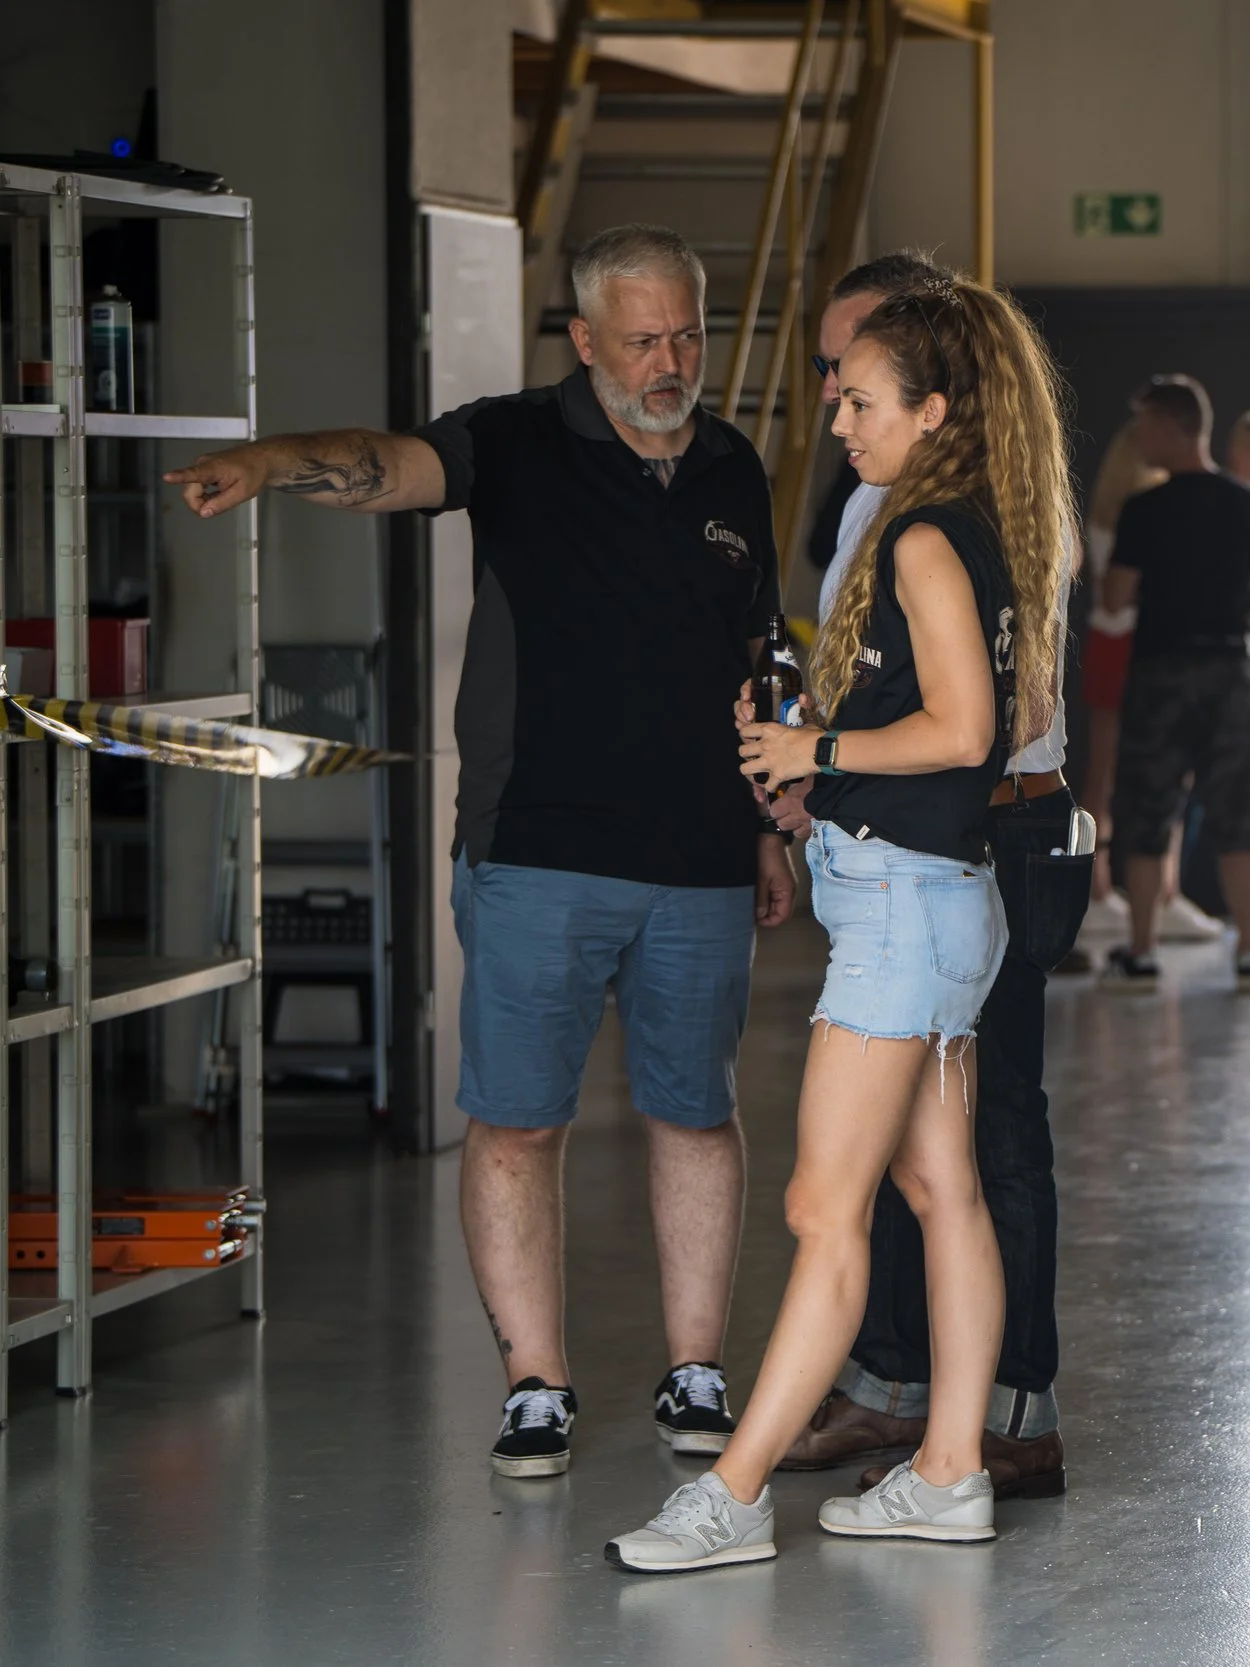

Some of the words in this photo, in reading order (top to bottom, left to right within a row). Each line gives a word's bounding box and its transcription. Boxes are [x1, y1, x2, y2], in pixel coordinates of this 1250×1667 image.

[858, 645, 882, 669] LINA
[875, 1489, 917, 1523] N
[693, 1515, 737, 1550] N
